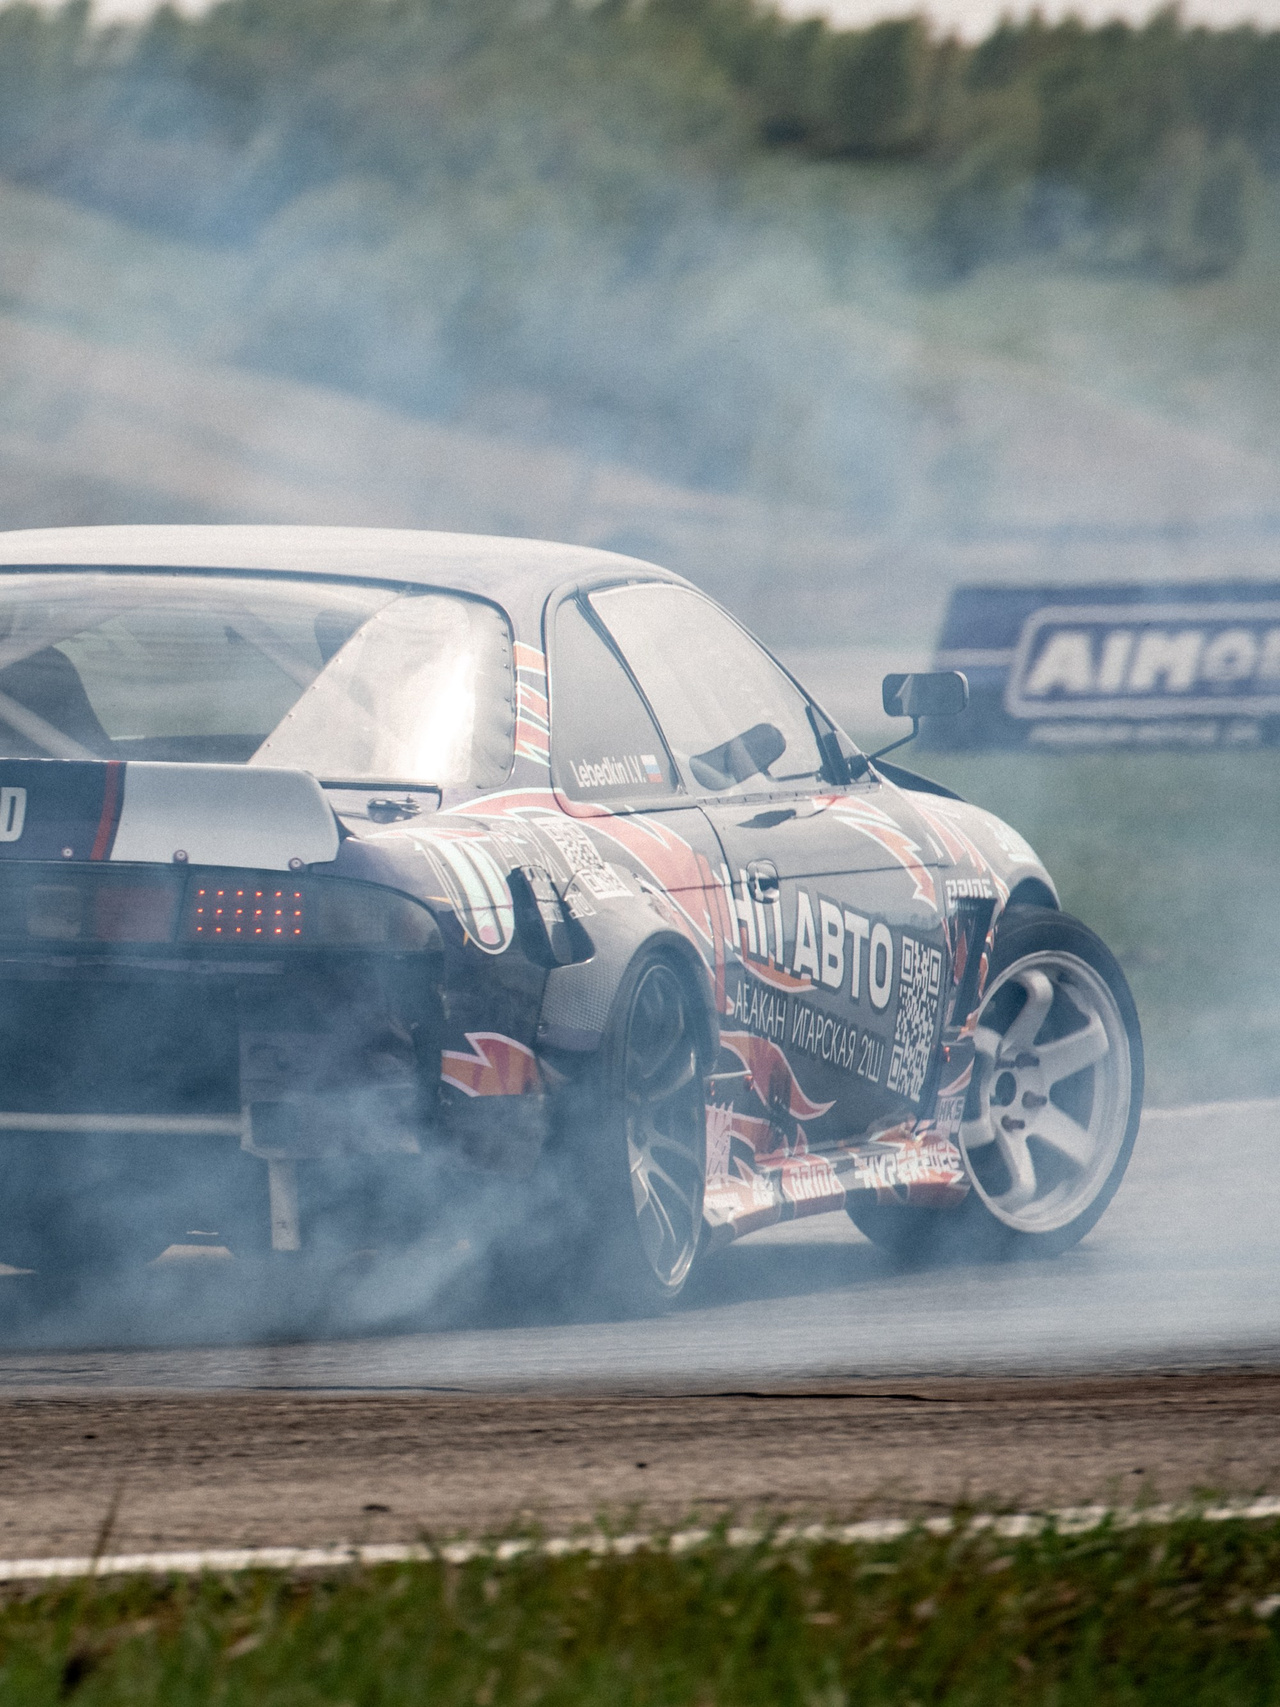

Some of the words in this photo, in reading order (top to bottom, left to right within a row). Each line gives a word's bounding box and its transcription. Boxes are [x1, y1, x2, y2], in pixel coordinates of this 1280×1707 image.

[570, 756, 629, 788] Lebedkin
[793, 891, 893, 1009] АВТО
[792, 1004, 857, 1071] ИГАРСКАЯ
